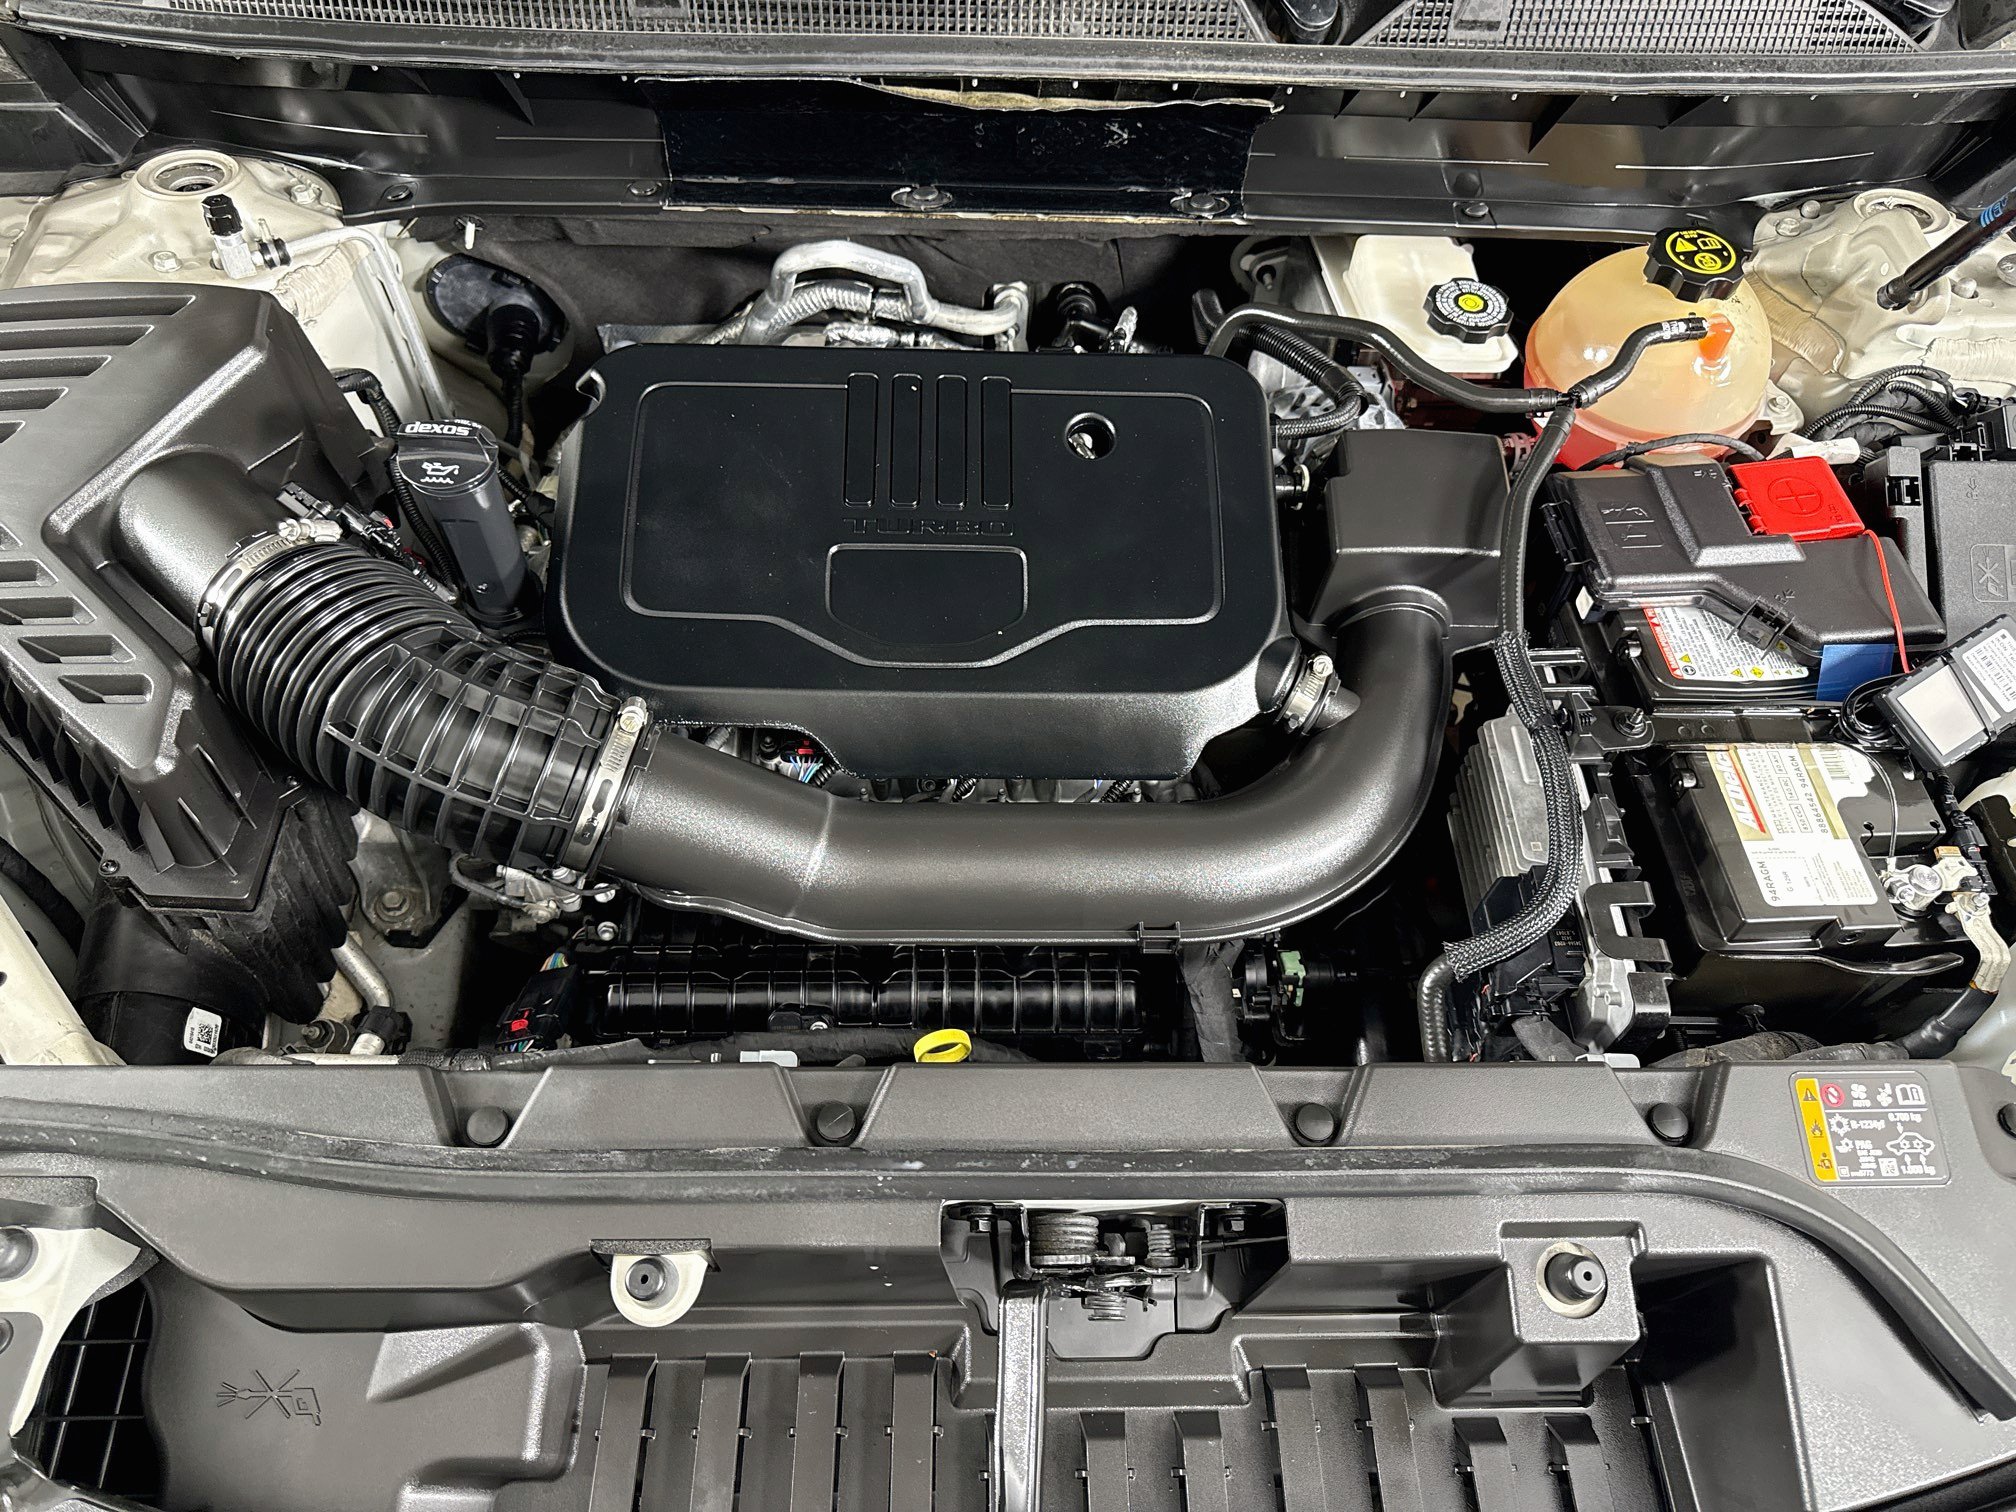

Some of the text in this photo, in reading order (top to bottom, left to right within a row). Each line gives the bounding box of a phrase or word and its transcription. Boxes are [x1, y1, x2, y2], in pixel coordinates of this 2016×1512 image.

[405, 421, 472, 436] dexos
[843, 518, 1013, 536] TURBO
[1788, 755, 1808, 788] 94RAGM
[1782, 779, 1789, 787] RC
[1786, 788, 1794, 798] 140
[1794, 806, 1803, 818] CCA
[1804, 792, 1828, 833] 88864542
[1800, 818, 1808, 830] 850
[1757, 861, 1780, 901] 94RAGM
[1910, 1113, 1922, 1123] kg
[1855, 1140, 1873, 1149] PAG
